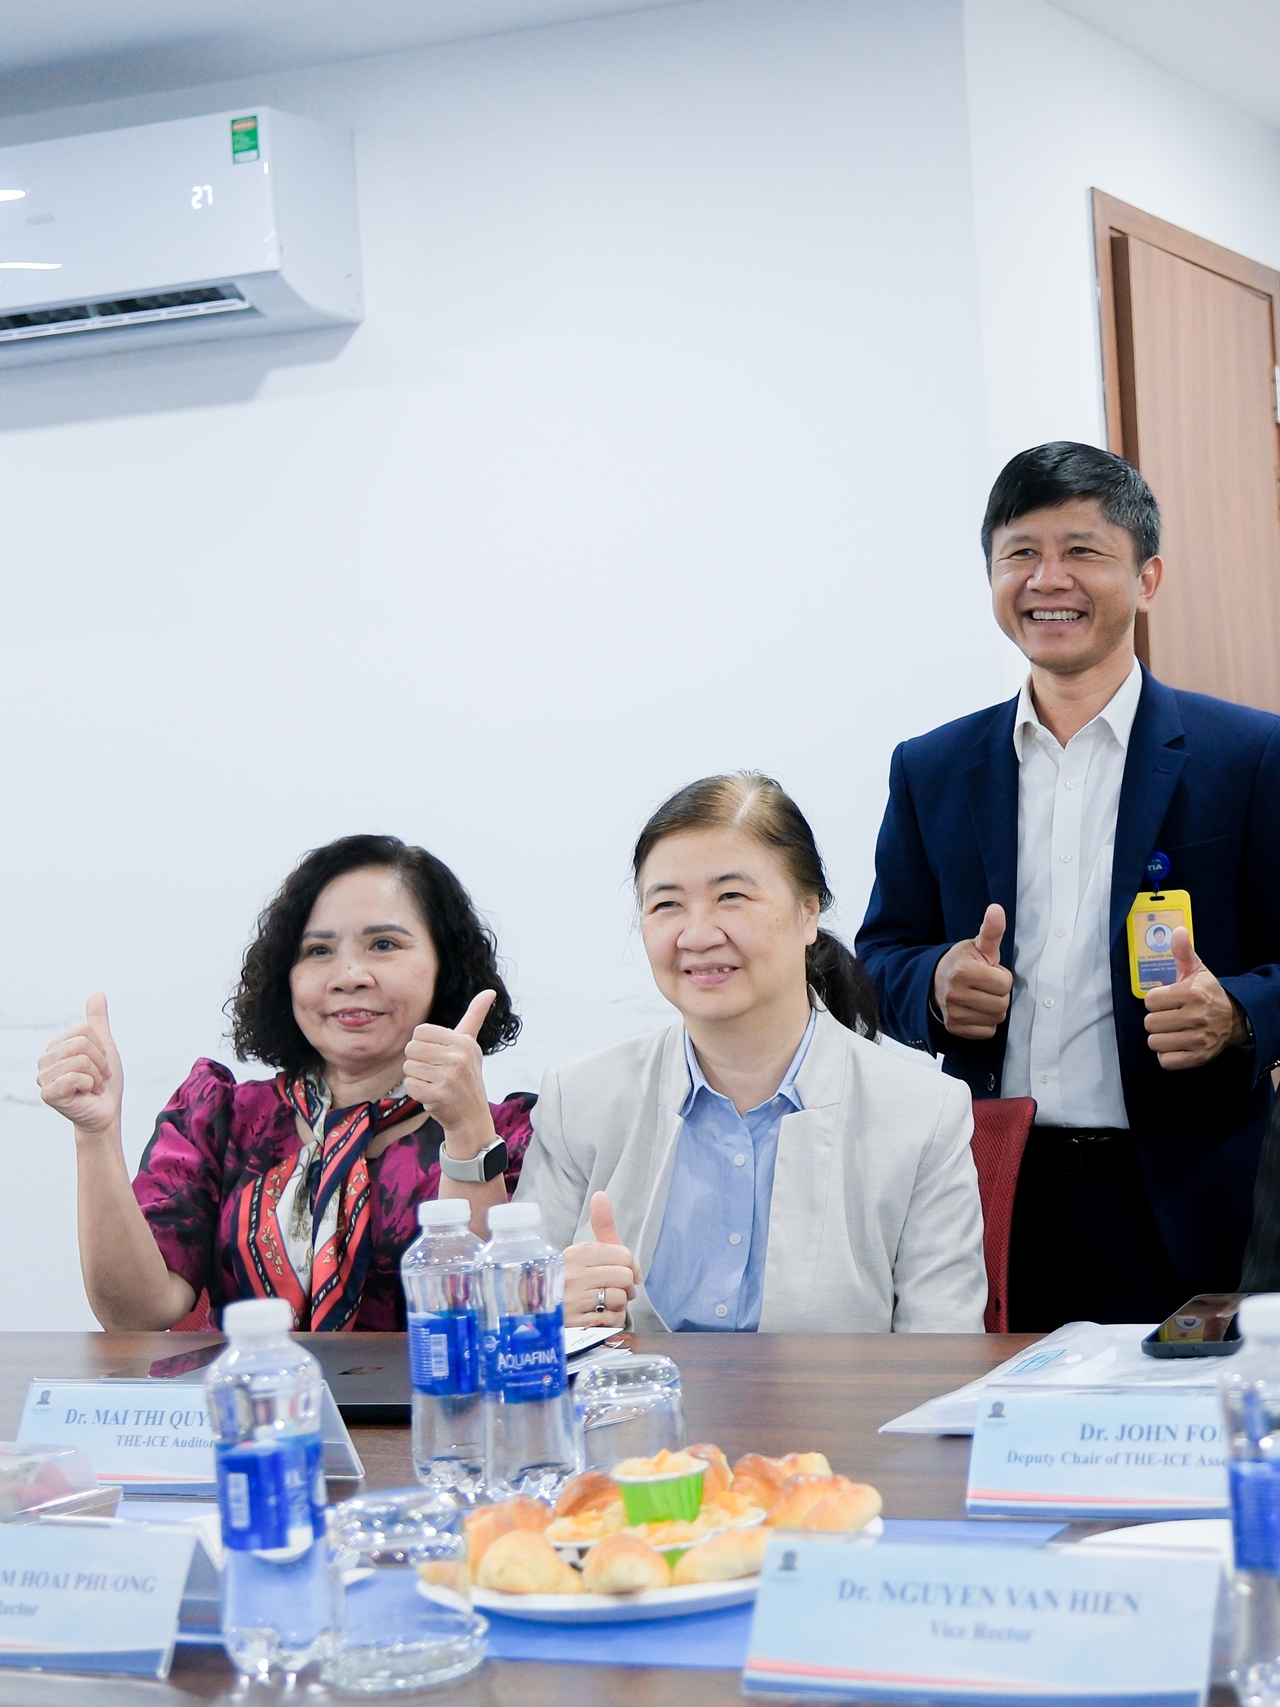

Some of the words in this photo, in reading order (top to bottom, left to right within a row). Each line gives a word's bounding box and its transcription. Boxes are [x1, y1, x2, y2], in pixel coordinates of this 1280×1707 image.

[191, 184, 213, 209] 27
[497, 1347, 558, 1370] AQUAFINA
[64, 1408, 87, 1425] Dr.
[92, 1409, 129, 1426] MAI
[133, 1410, 166, 1426] THI
[169, 1410, 212, 1430] QUY
[116, 1434, 169, 1448] THE-ICE
[171, 1435, 214, 1448] Auditor
[1079, 1423, 1108, 1441] Dr.
[1115, 1424, 1179, 1442] JOHN
[1007, 1450, 1055, 1467] Deputy
[1061, 1450, 1102, 1465] Chair
[1105, 1451, 1120, 1465] of
[1123, 1452, 1192, 1466] THE-ICE
[20, 1570, 71, 1590] HOAI
[74, 1573, 156, 1594] PHUONG
[837, 1578, 871, 1602] Dr.
[880, 1580, 996, 1608] NGUYEN
[1005, 1585, 1060, 1611] VAN
[1068, 1589, 1140, 1614] HIEN
[929, 1620, 967, 1638] Vice
[973, 1622, 1033, 1643] Rector
